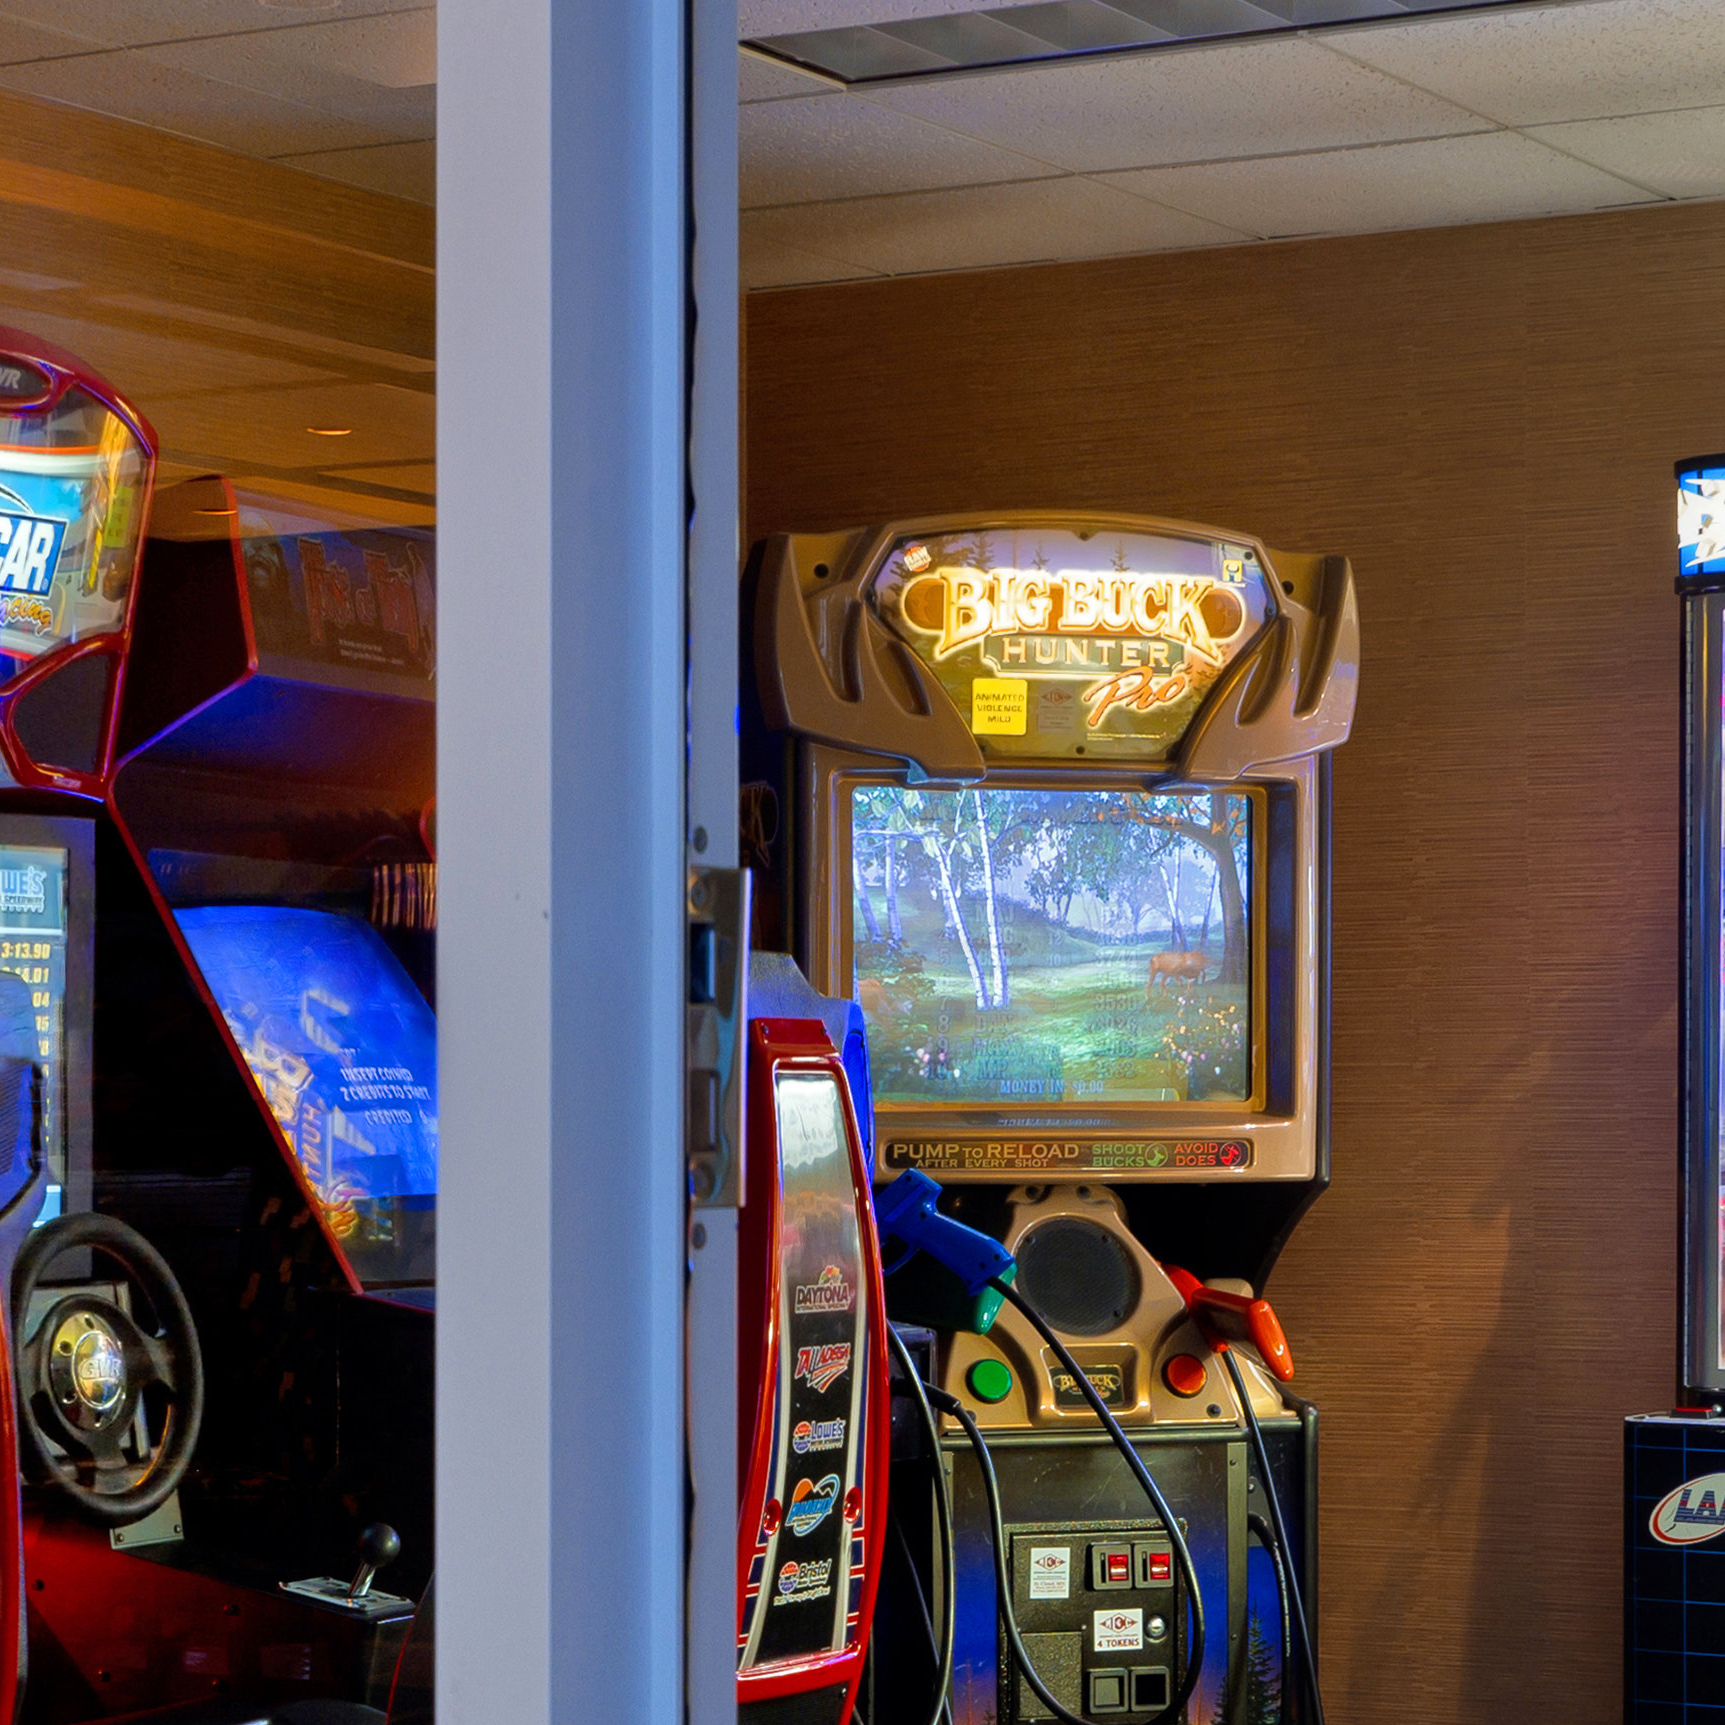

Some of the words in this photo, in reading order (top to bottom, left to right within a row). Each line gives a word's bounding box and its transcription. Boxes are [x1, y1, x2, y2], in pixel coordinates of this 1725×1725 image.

[935, 568, 1053, 660] BIG
[1059, 571, 1224, 666] BUCK
[1001, 638, 1171, 668] HUNTER
[974, 693, 1026, 703] ANIMATED
[1083, 667, 1187, 729] Pro
[976, 704, 1023, 714] VIOLENCE
[987, 714, 1012, 724] MILD
[893, 1143, 960, 1159] PUMP
[990, 1143, 1079, 1159] RELOAD
[1091, 1143, 1145, 1155] SHOOT
[1174, 1142, 1219, 1154] AVOID
[916, 1159, 958, 1168] AFTER
[965, 1159, 1008, 1168] EVERY
[1014, 1159, 1049, 1168] SHOT
[1091, 1156, 1145, 1168] BUCKS
[1175, 1155, 1217, 1167] DOES
[796, 1283, 851, 1306] DAYTONA
[810, 1418, 846, 1440] LOWE'S
[798, 1559, 833, 1579] Bristol
[1097, 1640, 1103, 1648] 4
[1106, 1638, 1140, 1648] TOKENS
